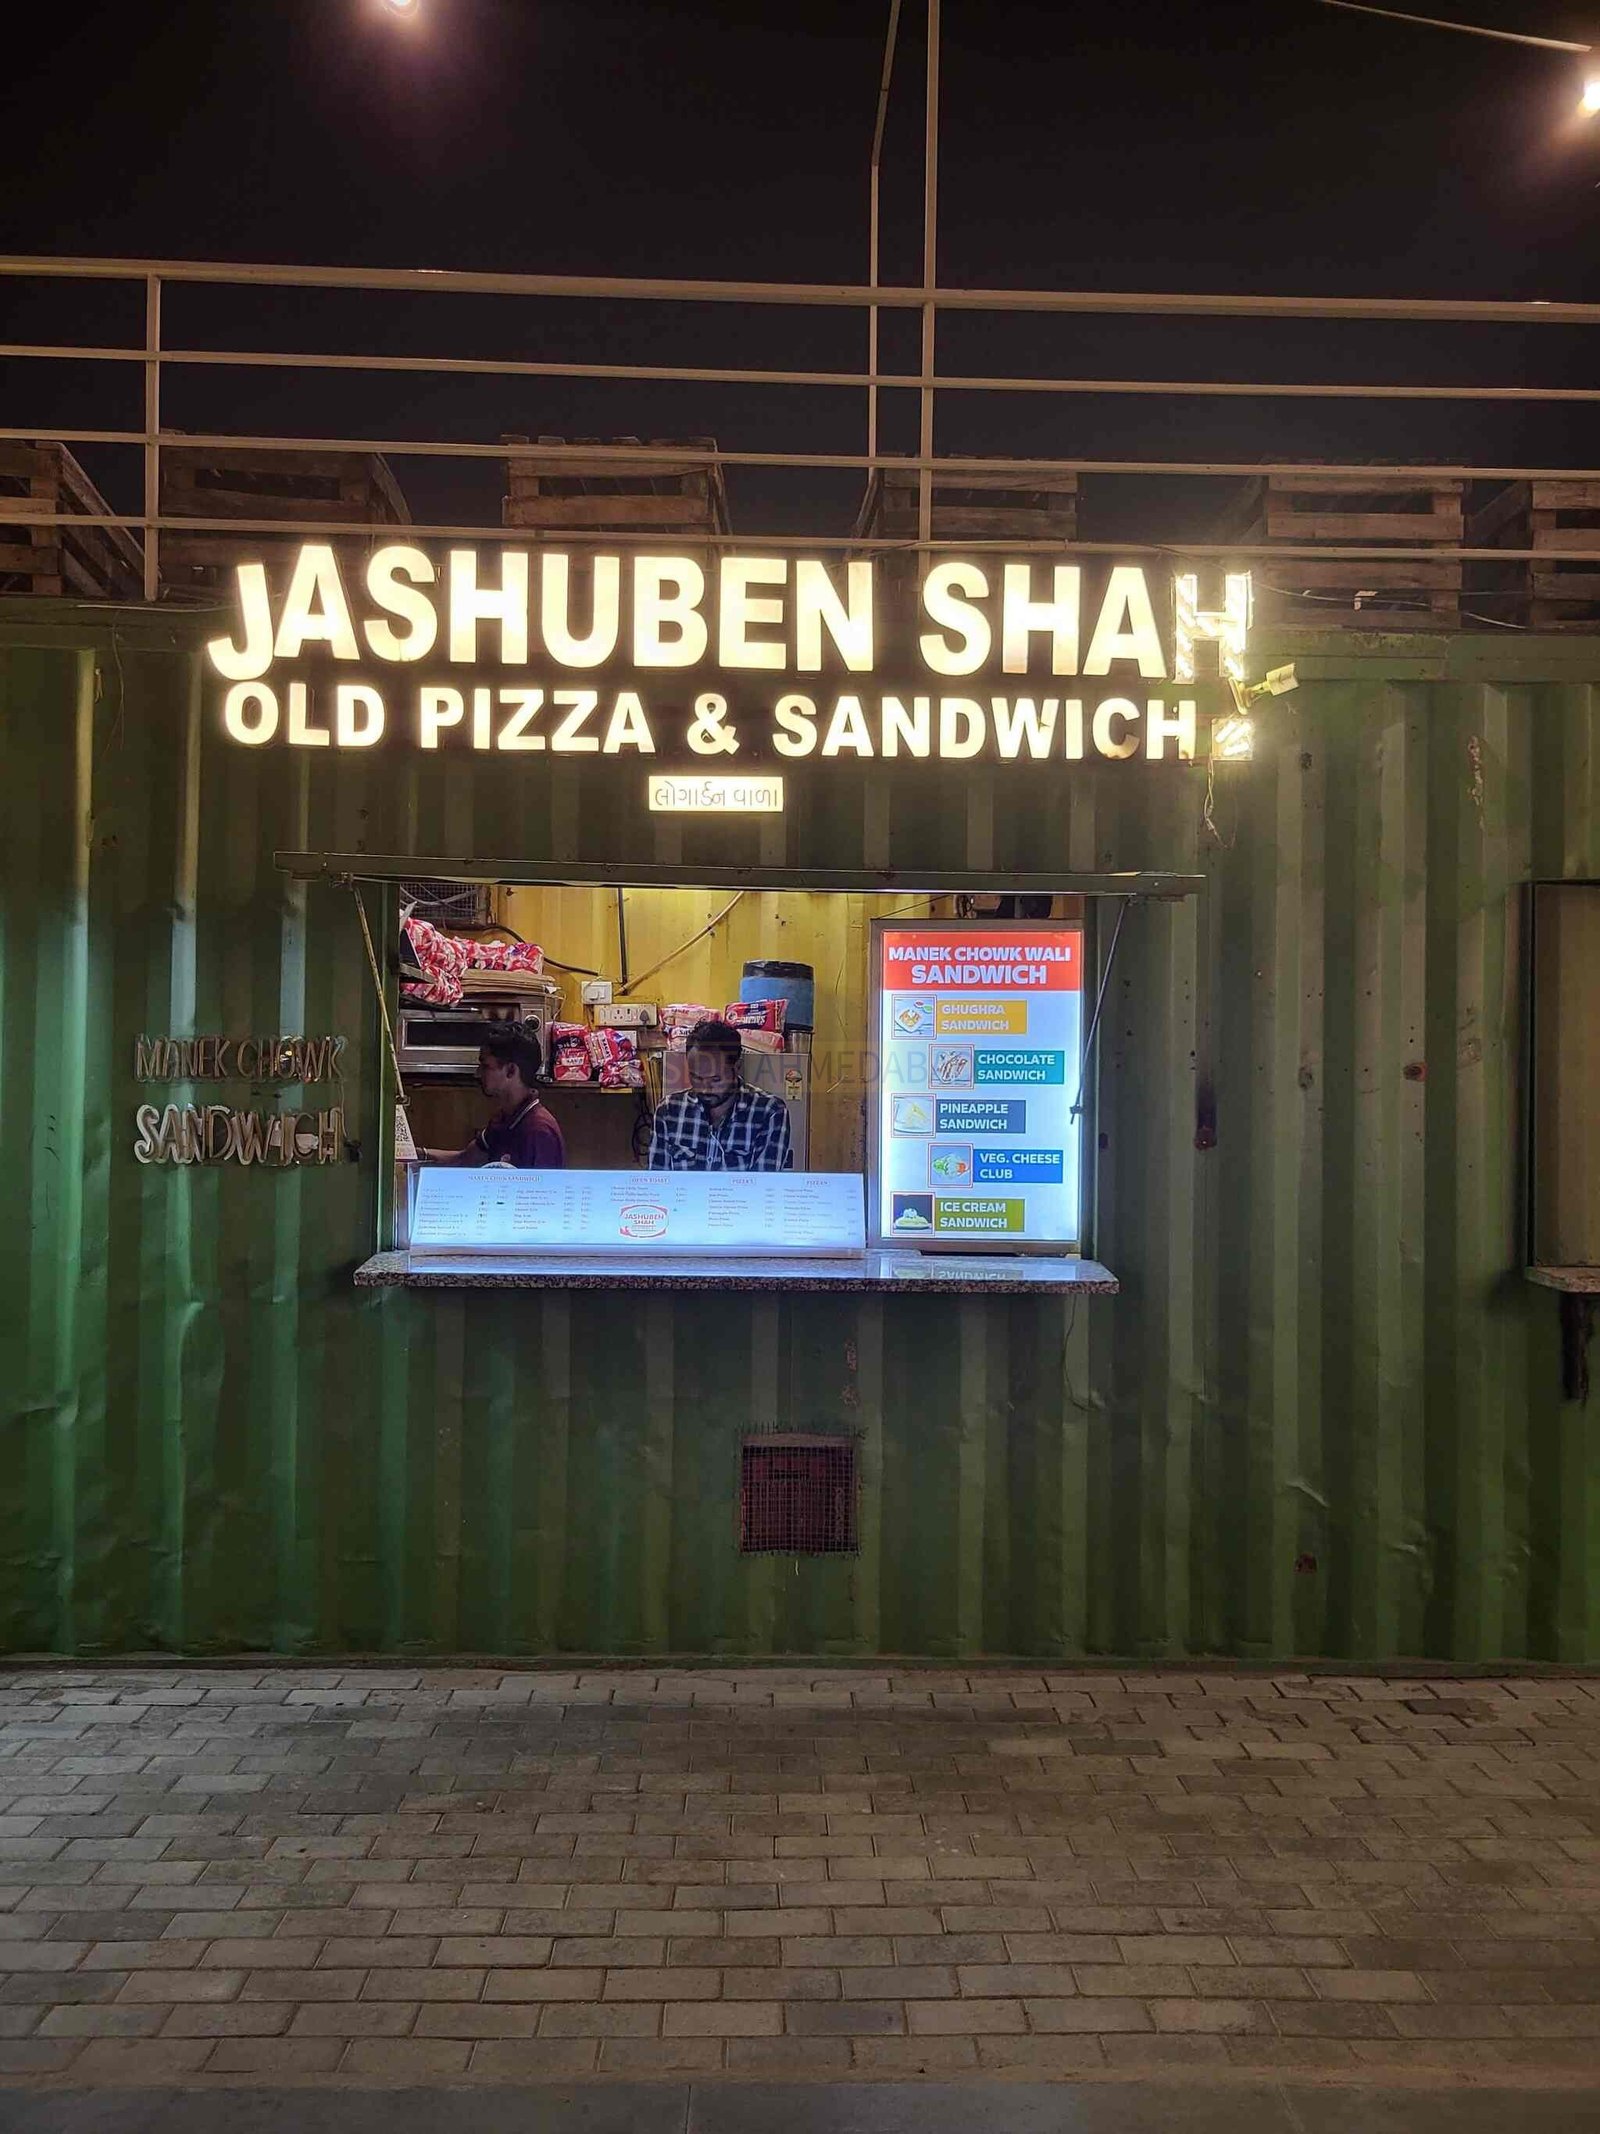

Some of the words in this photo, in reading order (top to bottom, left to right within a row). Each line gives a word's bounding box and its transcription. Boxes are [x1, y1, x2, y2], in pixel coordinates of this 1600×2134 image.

[207, 544, 874, 681] JASHUBEN
[919, 561, 1252, 685] SHAH
[224, 682, 386, 747] OLD
[420, 687, 656, 754] PIZZA
[687, 693, 740, 756] &
[772, 694, 1196, 761] SANDWICH
[889, 946, 952, 961] MANEK
[954, 946, 1023, 961] CHOWK
[1024, 946, 1071, 961] WALI
[911, 964, 1047, 985] SANDWICH
[941, 1003, 1005, 1015] GHUGHRA
[941, 1019, 1009, 1031] SANDWICH
[135, 1035, 231, 1082] MANEK
[237, 1035, 348, 1083] CHOWK
[978, 1054, 1055, 1065] CHOCOLATE
[977, 1069, 1046, 1081] SANDWICH
[940, 1103, 1009, 1115] PINEAPPLE
[940, 1118, 1008, 1130] SANDWICH
[134, 1103, 345, 1166] SANDWICH
[979, 1152, 1010, 1164] VEG.
[1012, 1152, 1060, 1164] CHEESE
[980, 1168, 1013, 1180] CLUB
[940, 1201, 961, 1213] ICE
[963, 1201, 1006, 1213] CREAM
[940, 1217, 1008, 1229] SANDWICH
